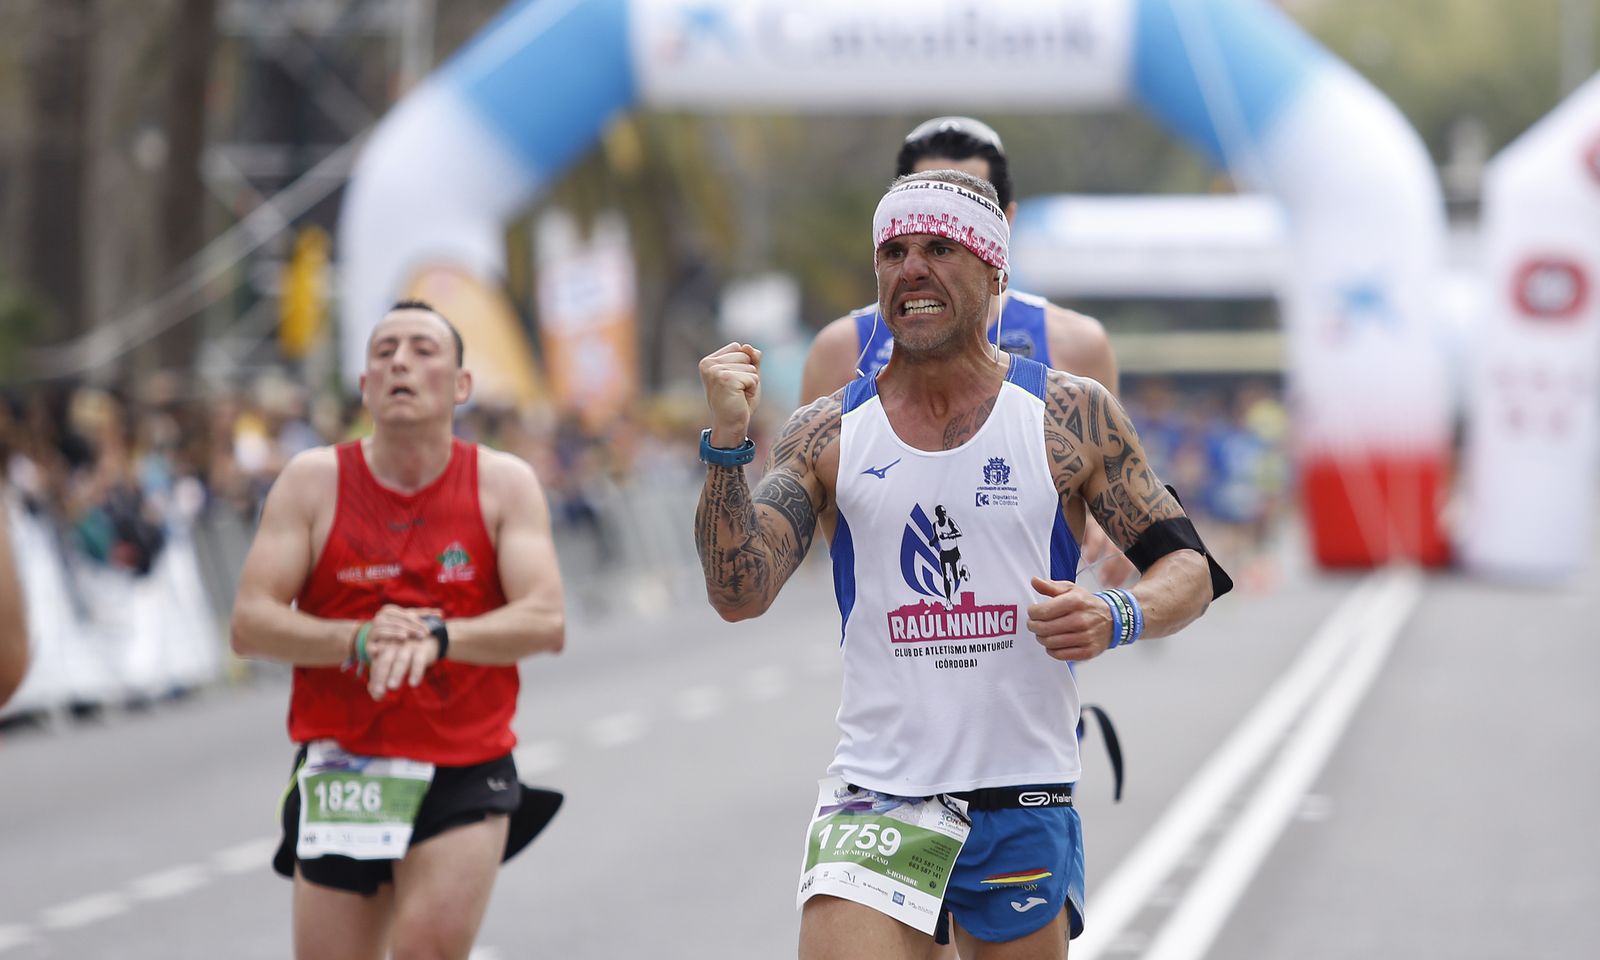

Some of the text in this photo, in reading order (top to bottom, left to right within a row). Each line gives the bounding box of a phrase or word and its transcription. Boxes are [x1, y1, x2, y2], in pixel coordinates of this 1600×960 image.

[933, 183, 954, 192] de
[957, 187, 1004, 222] Lucena
[891, 609, 1014, 640] RAÚLNNING
[894, 640, 1014, 657] CLUB DE ATLETISMO MONTURQUE
[935, 659, 978, 669] (CÓRDOBA)
[314, 781, 381, 812] 1826
[818, 823, 902, 857] 1759
[850, 850, 871, 858] NIETO
[871, 854, 889, 866] CANO
[885, 868, 919, 887] S-HOMBRE
